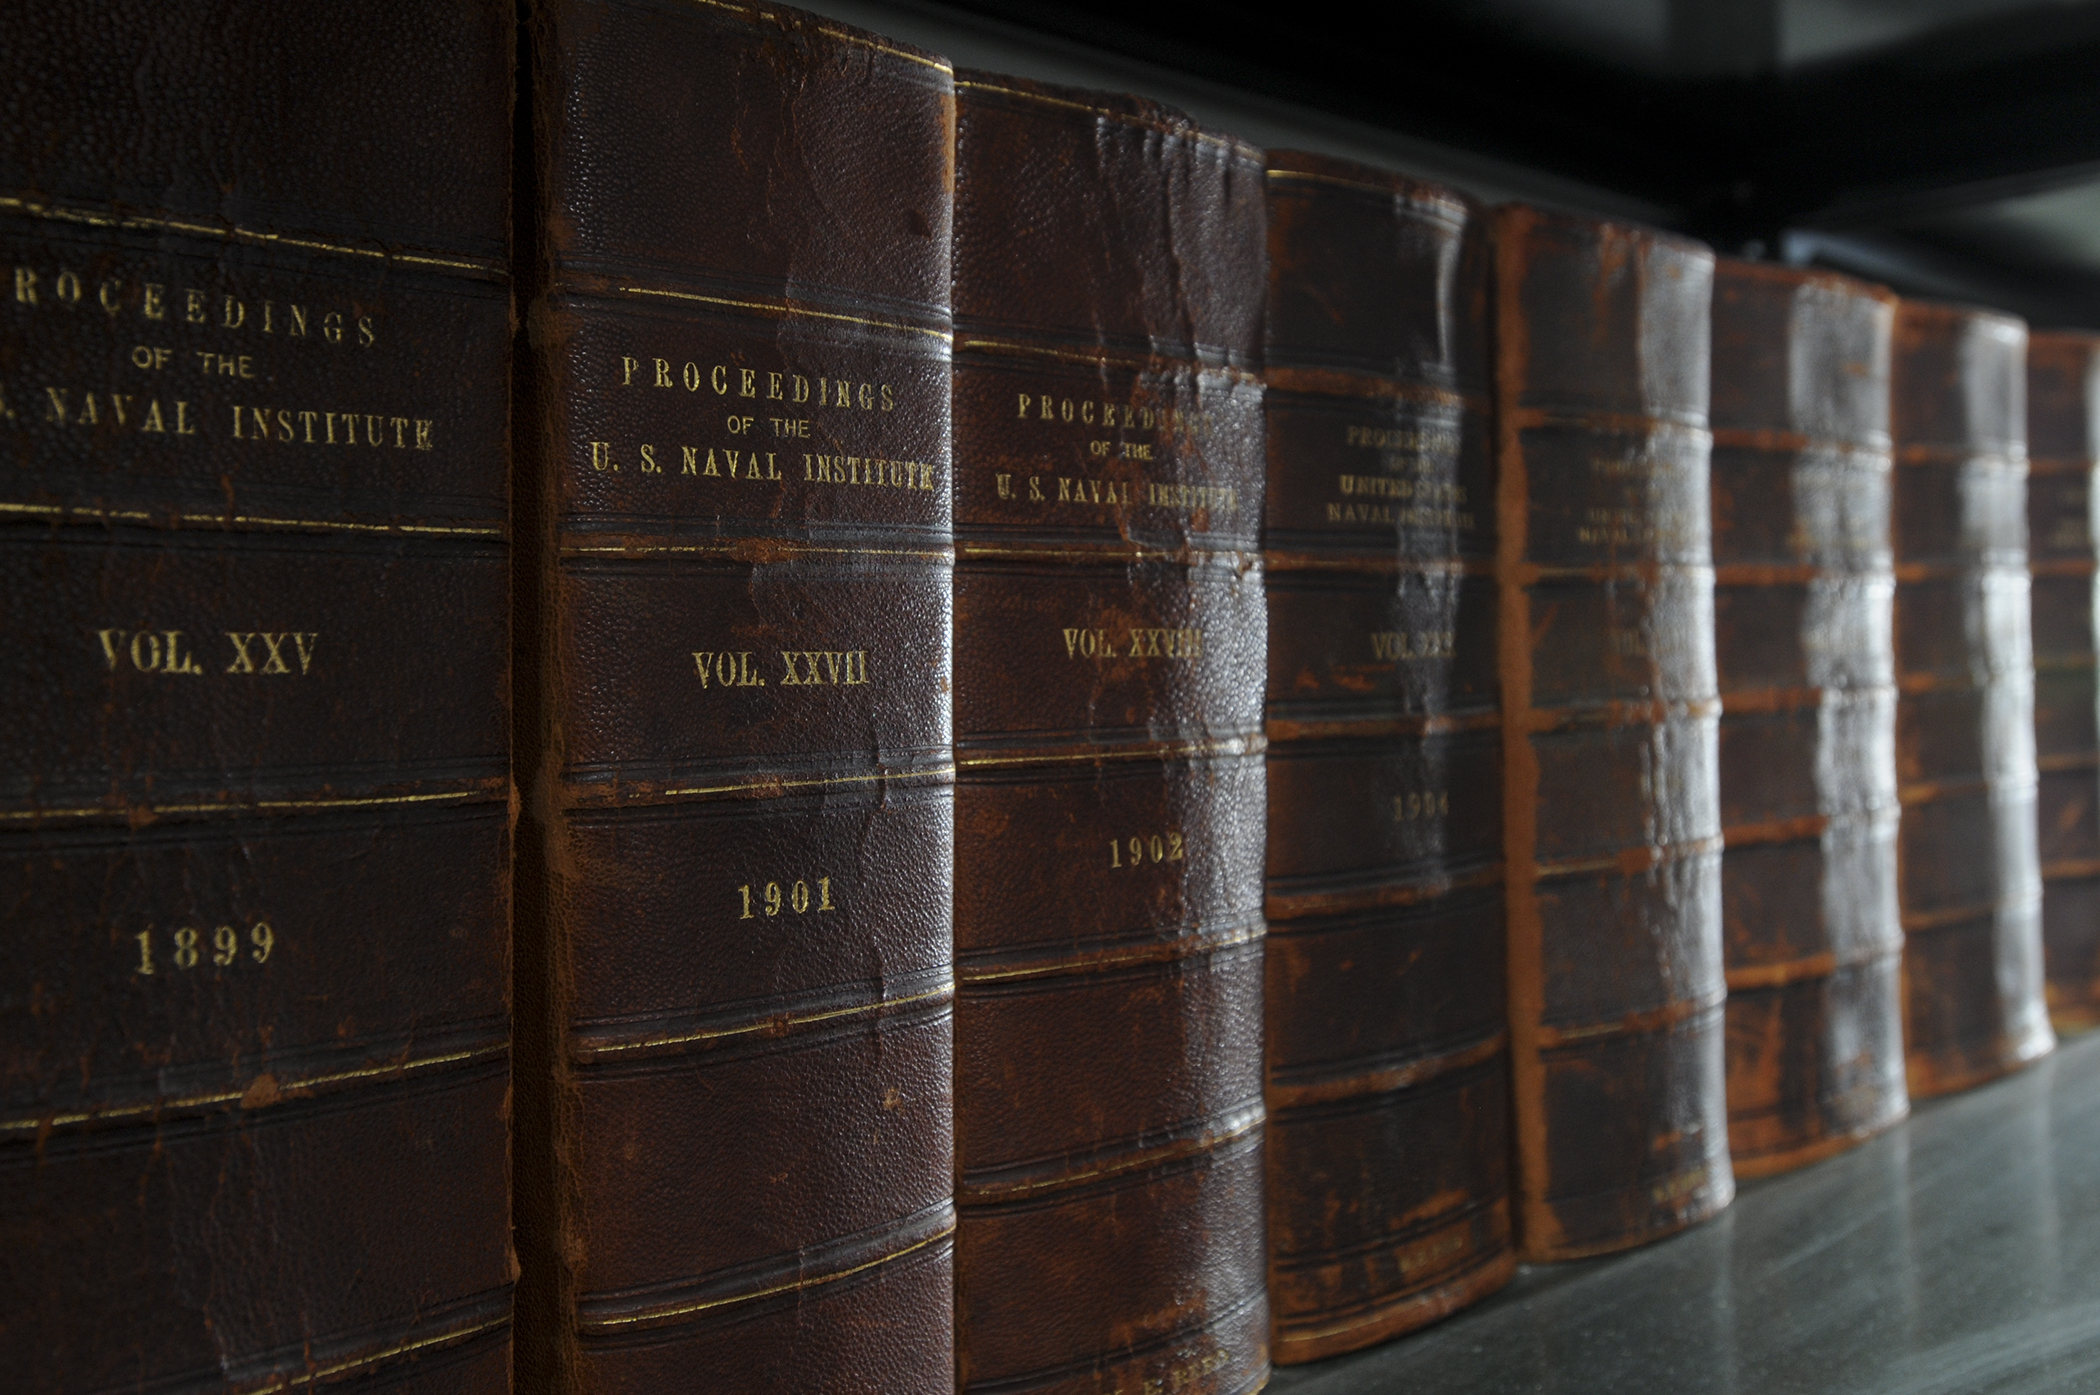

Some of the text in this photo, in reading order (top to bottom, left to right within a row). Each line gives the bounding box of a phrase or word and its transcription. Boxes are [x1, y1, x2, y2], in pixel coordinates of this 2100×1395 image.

[13, 265, 375, 348] ROCEEDINGS
[131, 345, 256, 379] OF THE
[620, 355, 895, 413] PROCEEDINGS
[45, 385, 197, 436] NAVAL
[231, 404, 434, 451] INSTITUTE
[726, 415, 811, 439] OF THE
[589, 440, 935, 491] U. S. NAVAL INSTITUTE
[1089, 440, 1153, 461] OF THE
[995, 473, 1017, 500] U.
[1028, 475, 1046, 502] S.
[1057, 477, 1134, 504] NAVAL
[1338, 473, 1414, 499] UNITED
[1326, 502, 1395, 524] NAVAL
[98, 627, 319, 677] VOL. XXV
[1062, 628, 1118, 660] VOL.
[691, 650, 870, 689] VOL. XXVII
[1109, 832, 1184, 869] 1902
[737, 876, 836, 920] 1901
[134, 921, 275, 976] 1899
